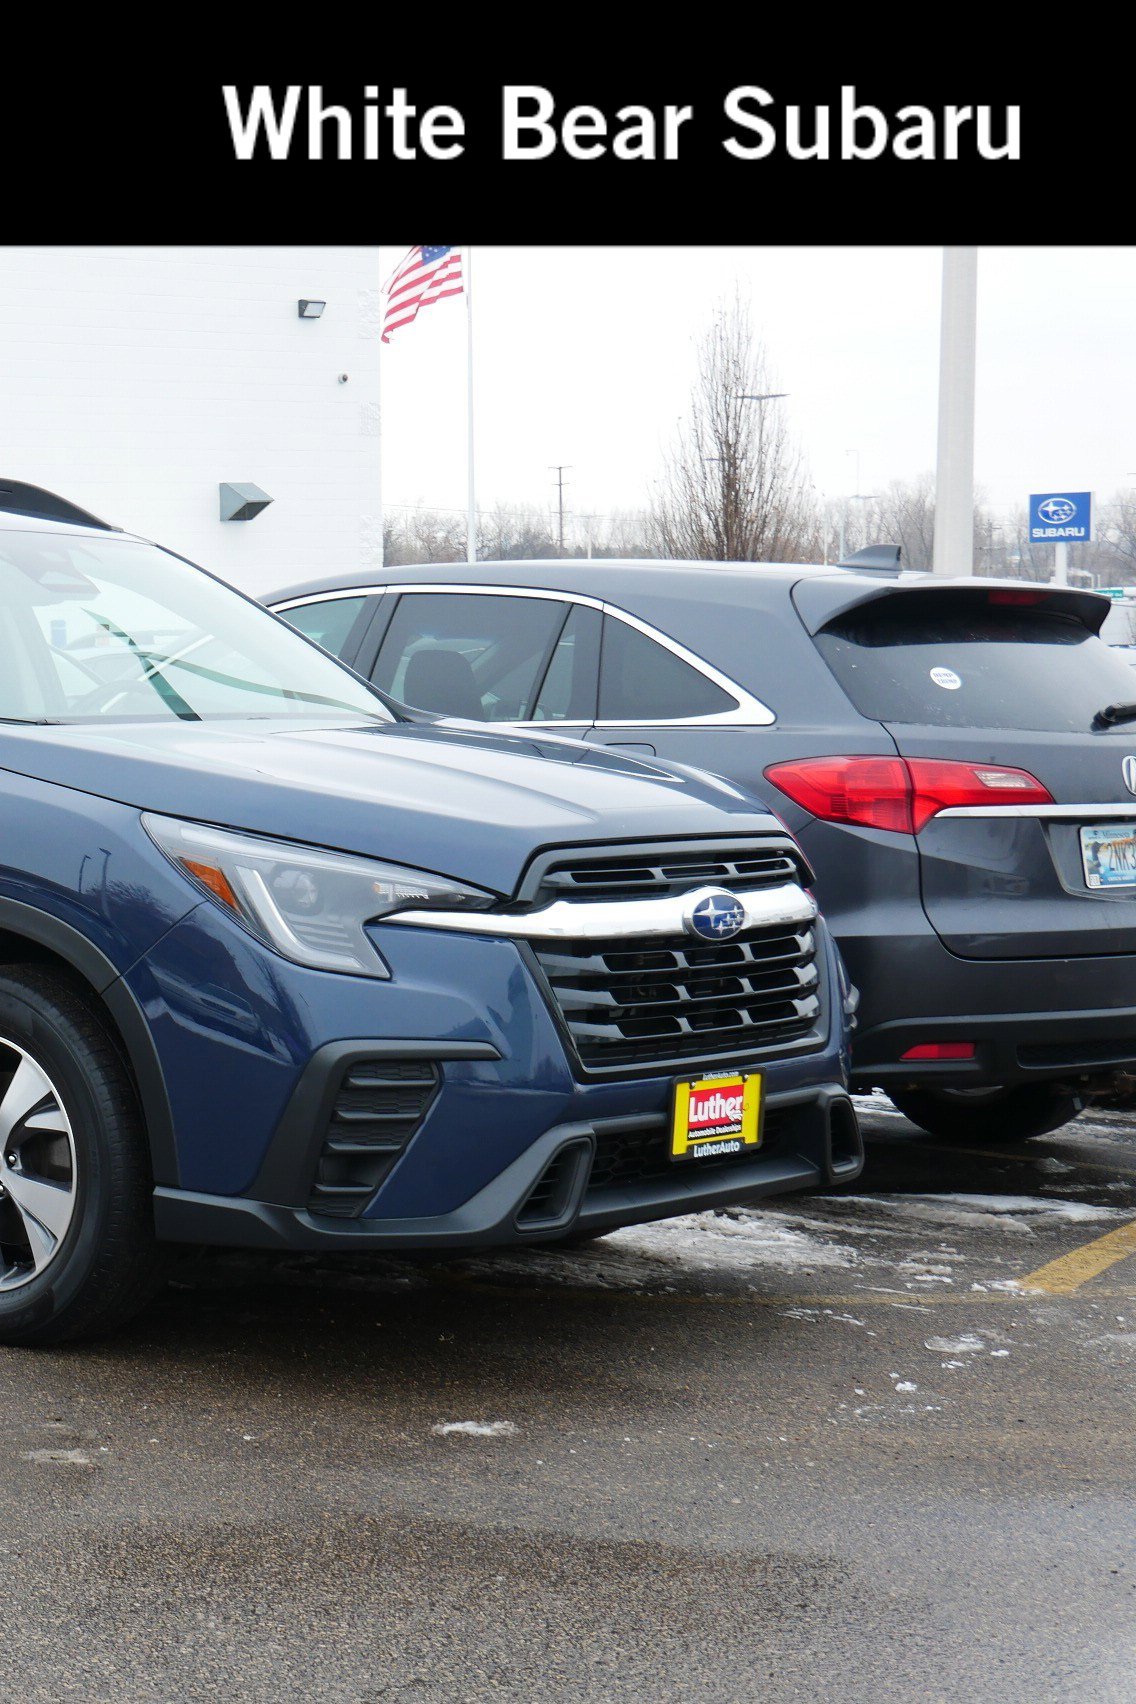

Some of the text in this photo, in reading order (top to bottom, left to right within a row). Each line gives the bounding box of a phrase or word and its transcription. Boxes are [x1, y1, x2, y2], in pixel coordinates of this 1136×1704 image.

[1032, 527, 1085, 538] SUBARU
[689, 1093, 743, 1122] Luther
[694, 1141, 740, 1157] LutherAuto
